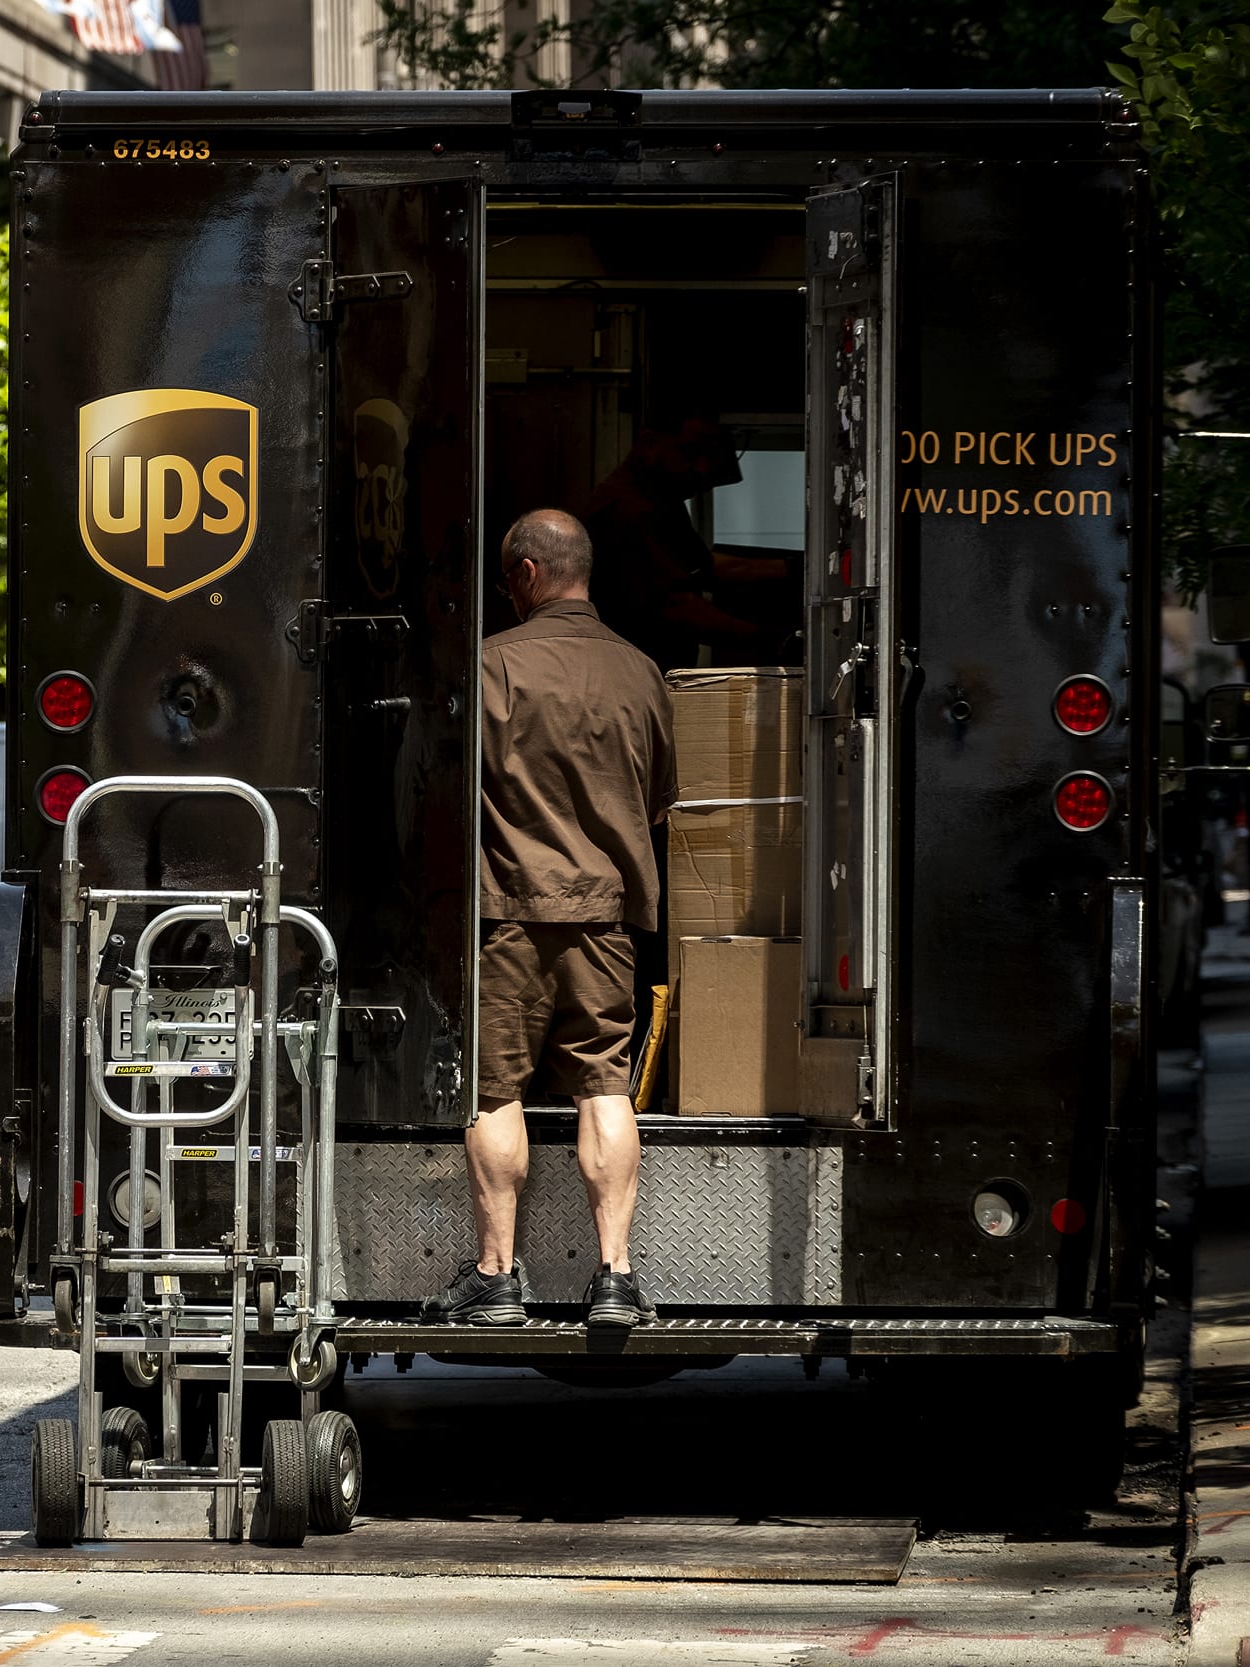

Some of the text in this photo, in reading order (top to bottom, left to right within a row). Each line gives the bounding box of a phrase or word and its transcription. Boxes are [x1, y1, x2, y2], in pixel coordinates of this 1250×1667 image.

[113, 138, 211, 160] 675483
[954, 431, 1036, 466] PICK
[1049, 432, 1118, 467] UPS
[91, 454, 247, 568] ups
[152, 993, 222, 1009] Illinois
[116, 1065, 152, 1074] HARPER
[182, 1149, 217, 1157] HARPER
